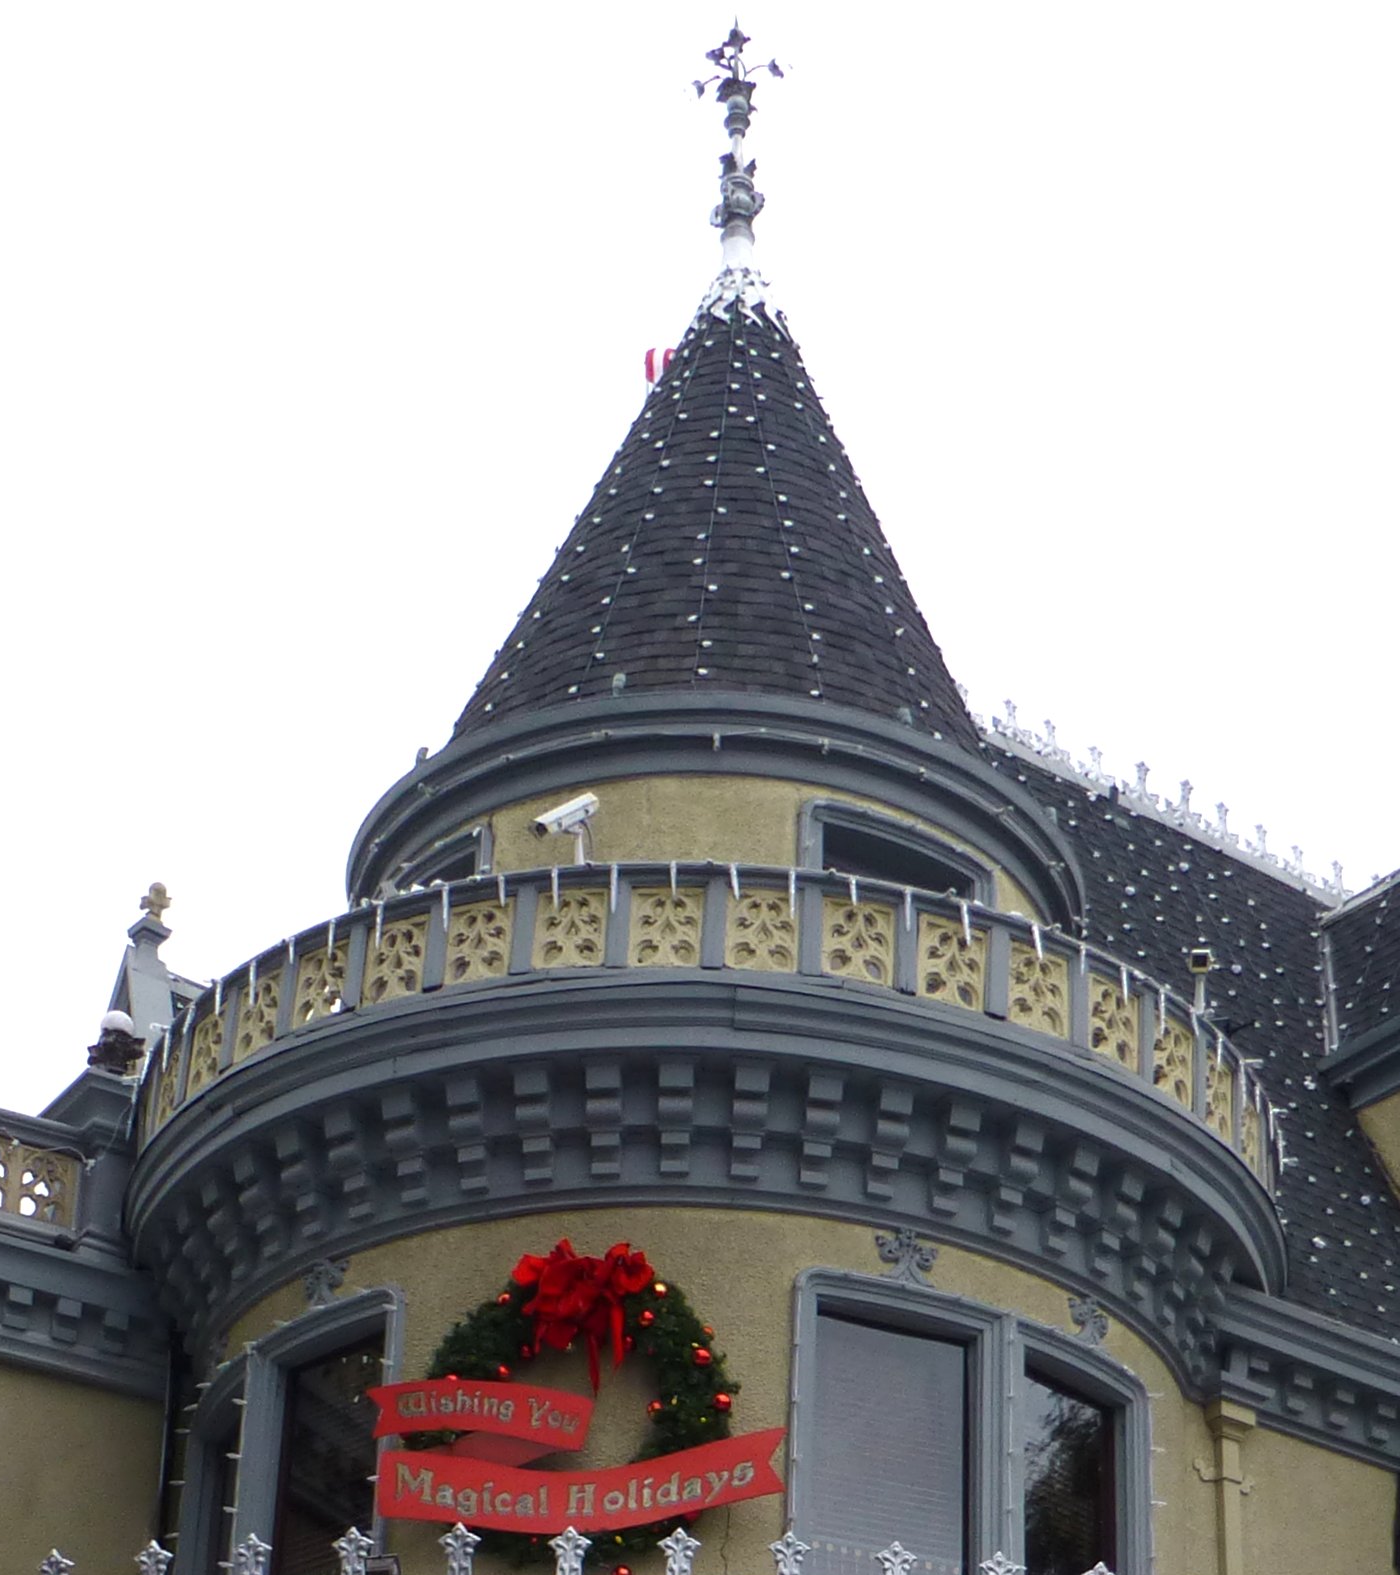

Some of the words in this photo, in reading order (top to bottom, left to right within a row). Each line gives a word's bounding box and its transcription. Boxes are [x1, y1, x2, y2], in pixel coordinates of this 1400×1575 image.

[396, 1388, 514, 1422] Wishing
[527, 1397, 580, 1435] You
[394, 1462, 549, 1517] Magical
[566, 1460, 755, 1517] Holidays
